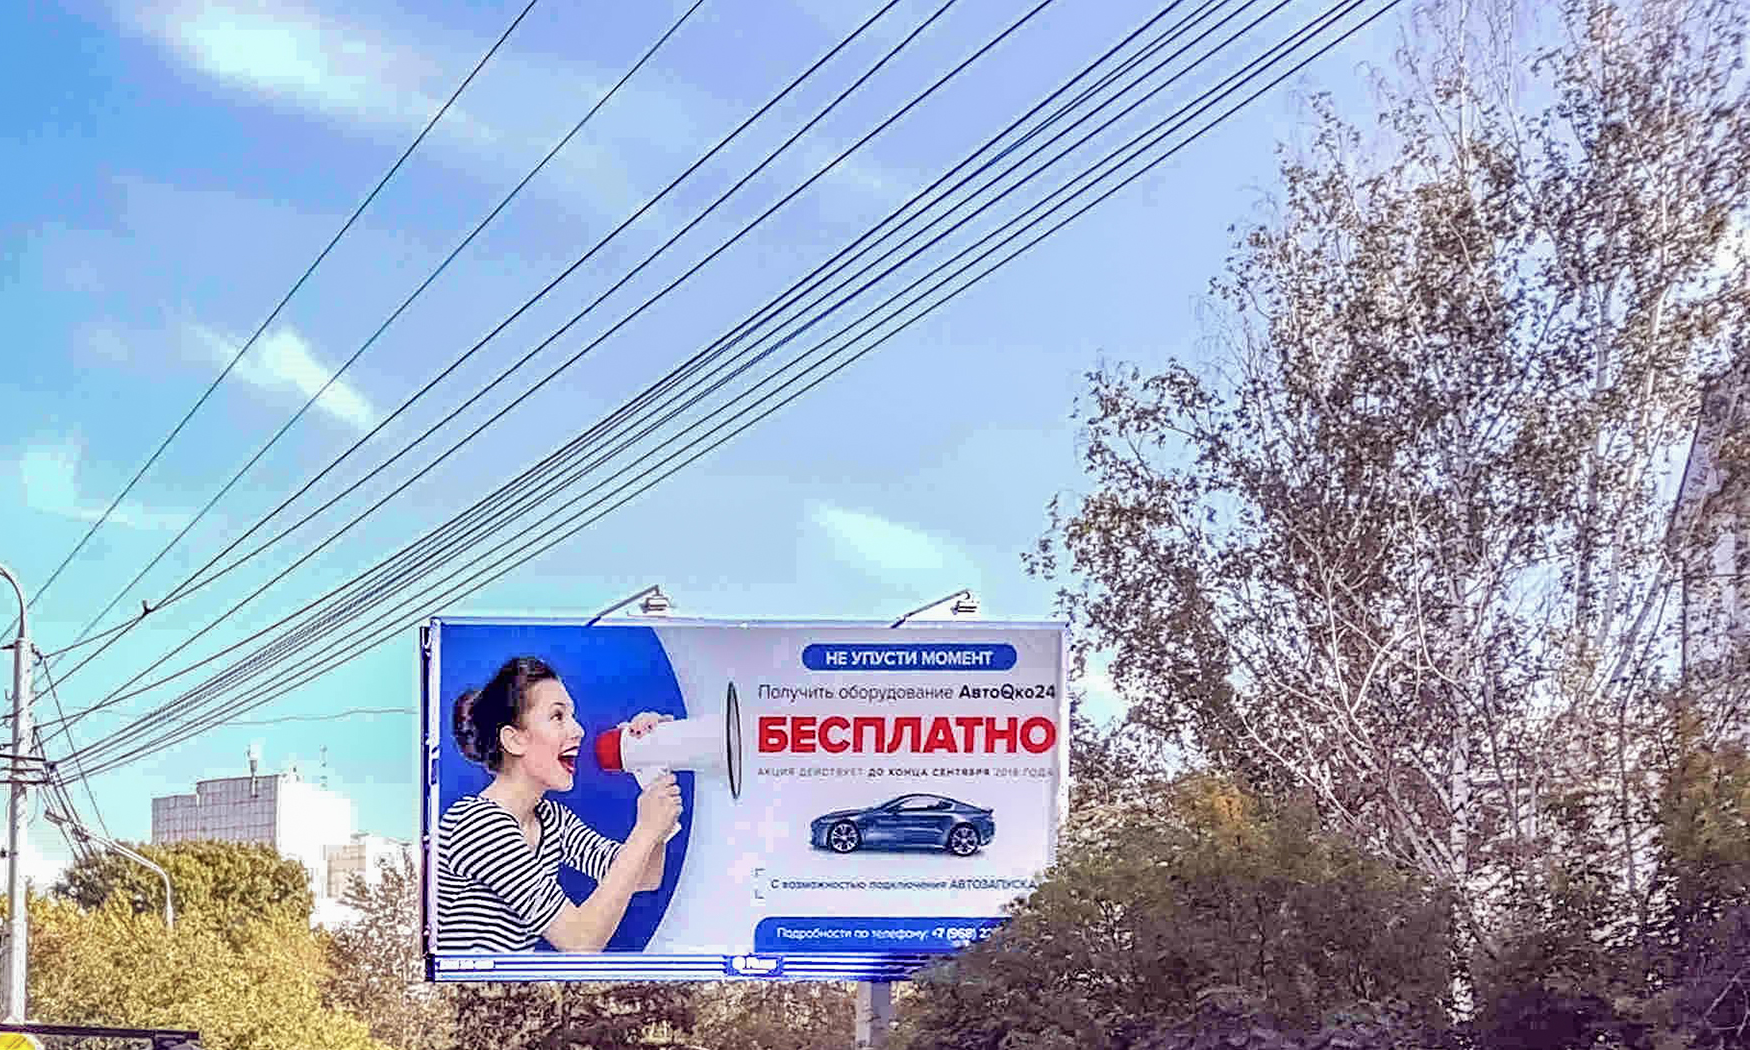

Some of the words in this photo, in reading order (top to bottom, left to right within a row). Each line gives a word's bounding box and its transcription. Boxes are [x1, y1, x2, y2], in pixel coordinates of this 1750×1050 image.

[826, 651, 848, 665] НЕ
[851, 651, 918, 666] УПУСТИ
[921, 651, 994, 665] МОМЕНТ
[758, 684, 834, 703] Получить
[838, 684, 953, 703] оборудование
[758, 716, 1056, 753] БЕСПЛАТНО
[777, 927, 851, 940] Подробности
[854, 930, 869, 938] по
